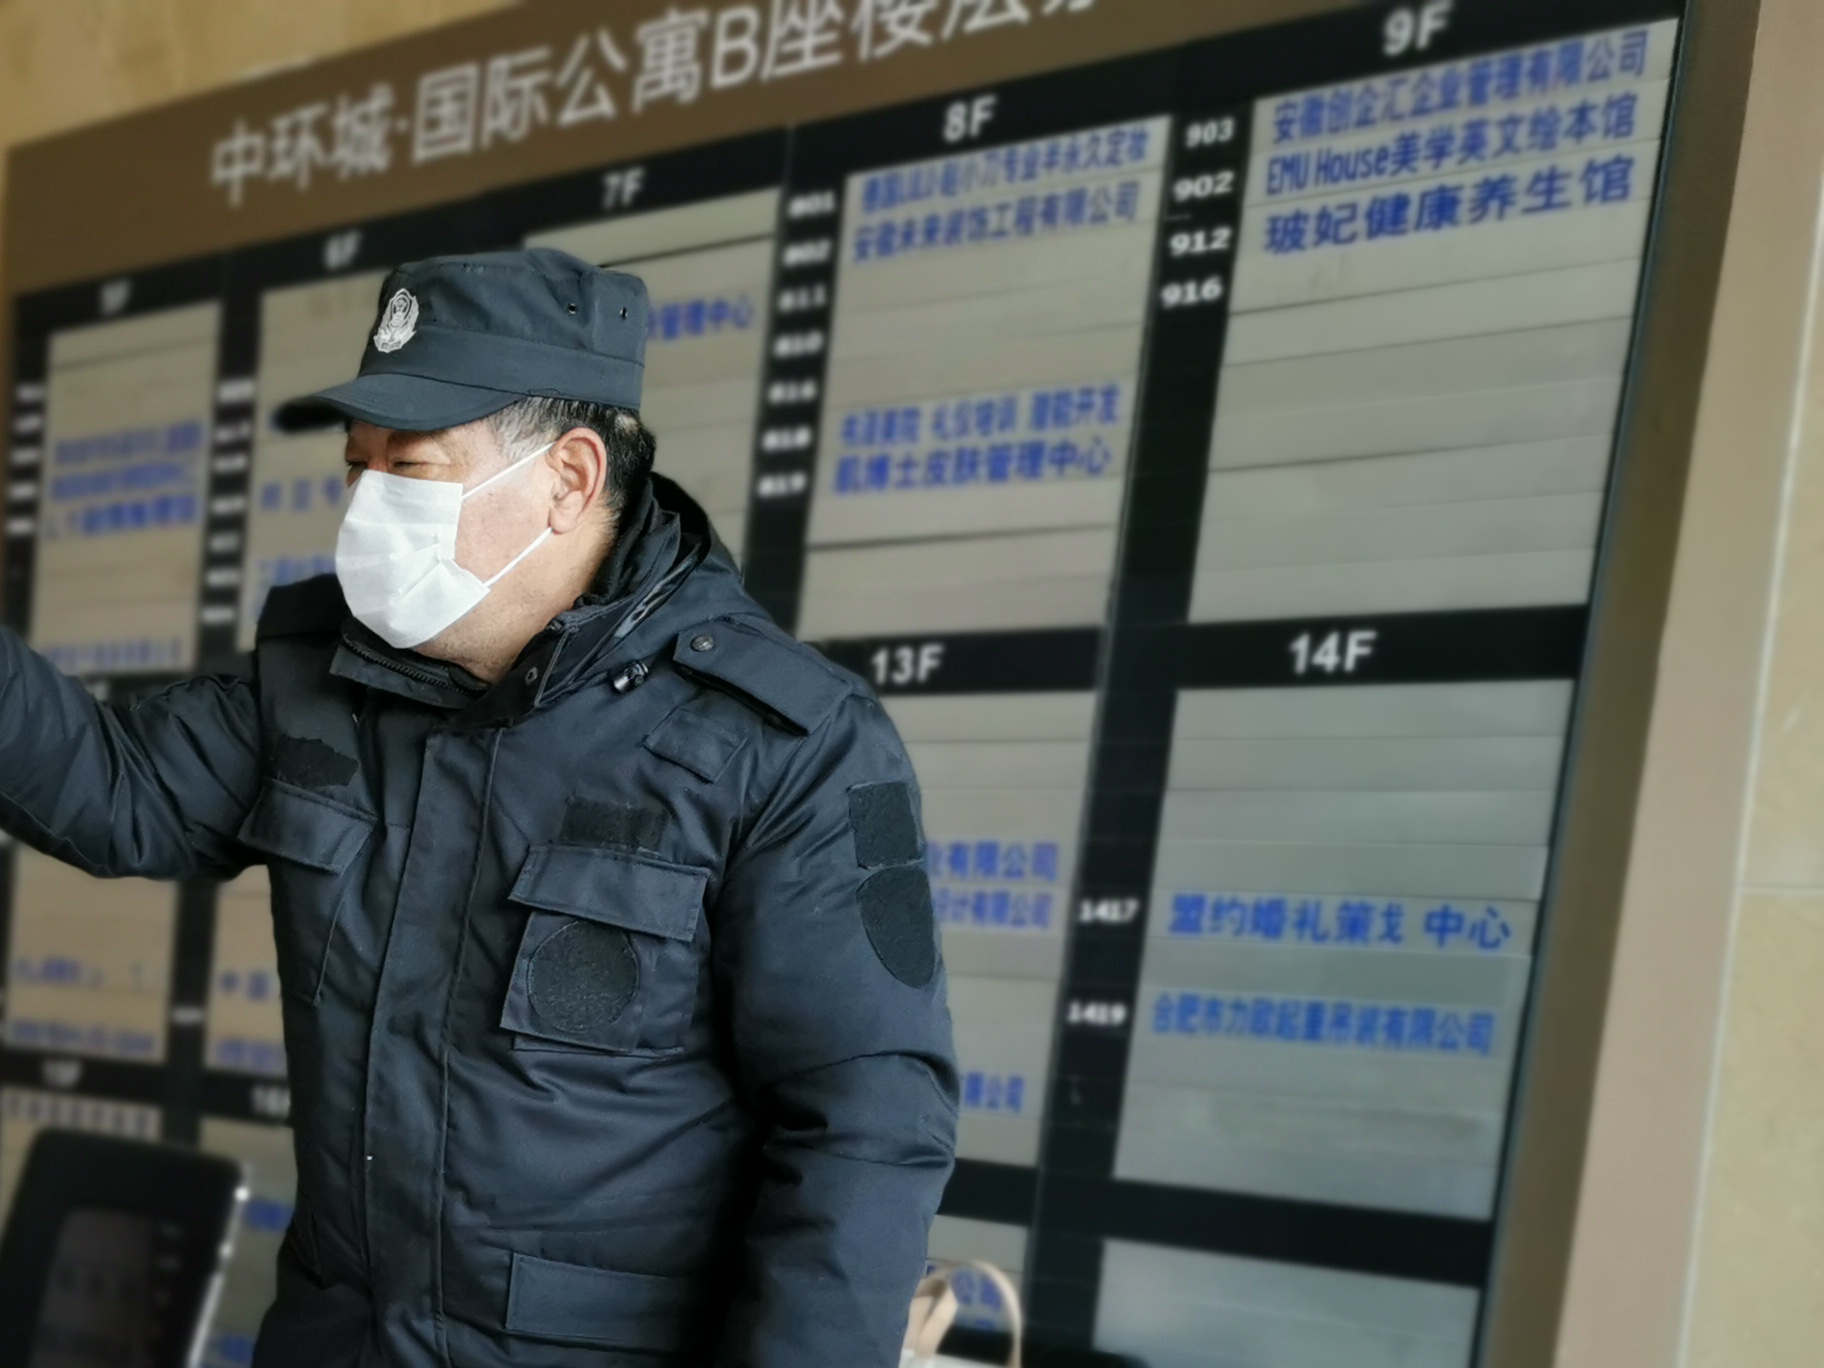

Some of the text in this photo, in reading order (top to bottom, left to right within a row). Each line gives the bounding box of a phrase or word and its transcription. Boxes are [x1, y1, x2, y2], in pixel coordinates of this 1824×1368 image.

[1383, 3, 1453, 56] 9F
[210, 0, 1096, 208] 中环城·国际公寓B座楼
[943, 95, 997, 143] 8F
[1186, 118, 1236, 149] 903
[1174, 171, 1235, 201] 902
[1263, 154, 1636, 256] 玻妃健康养生馆
[1169, 227, 1232, 256] 912
[1162, 277, 1223, 308] 916
[872, 644, 944, 685] 13F
[1289, 631, 1377, 676] 14F
